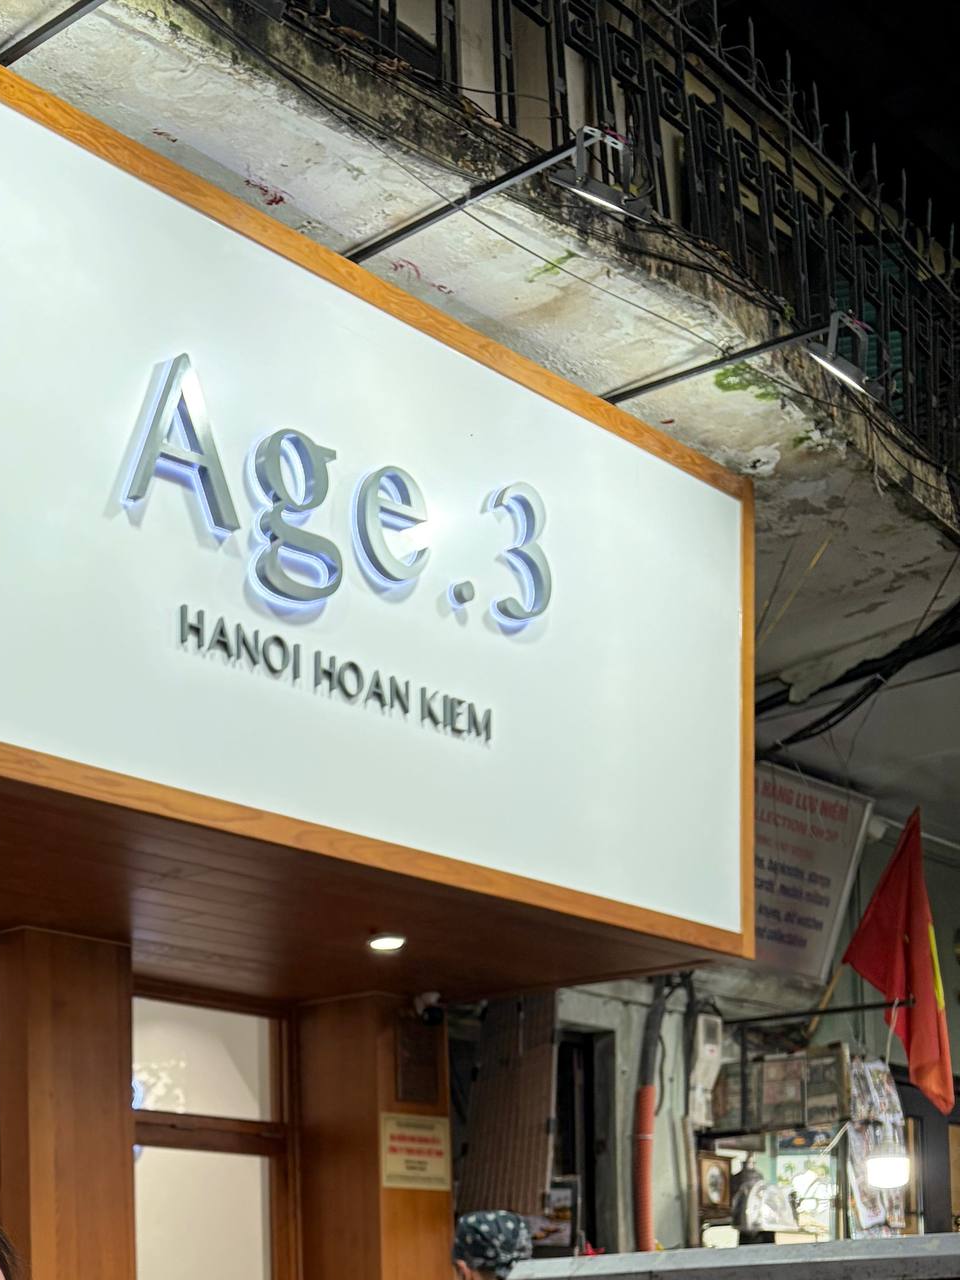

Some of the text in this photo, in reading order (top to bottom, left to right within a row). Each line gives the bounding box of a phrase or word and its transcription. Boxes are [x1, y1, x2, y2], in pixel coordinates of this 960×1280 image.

[124, 353, 552, 621] Age.3
[179, 603, 492, 741] HANOI HOAN KIEM
